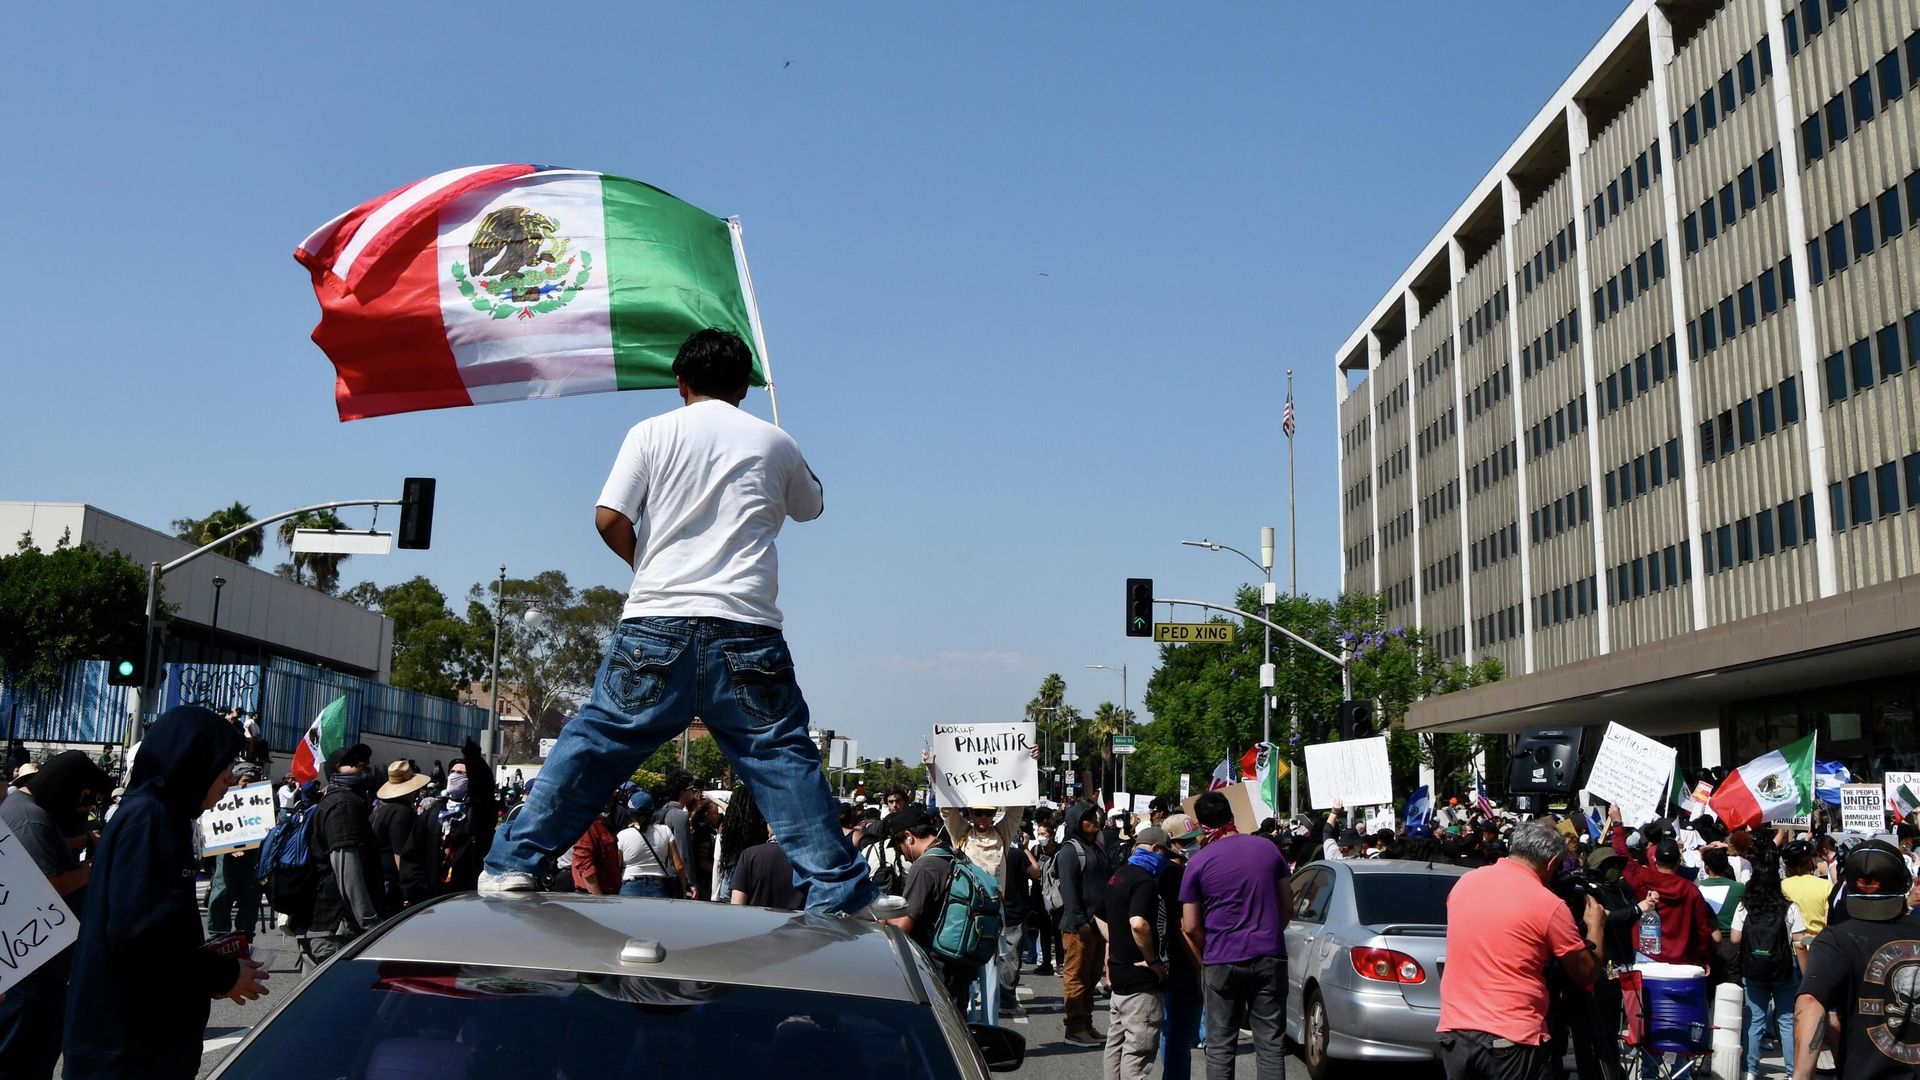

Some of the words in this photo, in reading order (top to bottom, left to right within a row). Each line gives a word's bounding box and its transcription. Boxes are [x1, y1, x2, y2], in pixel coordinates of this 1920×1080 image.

[1161, 627, 1189, 639] PED
[1195, 627, 1227, 639] XING
[977, 757, 999, 765] AND
[945, 770, 992, 786] PETER
[976, 779, 1022, 794] THIEL
[210, 794, 244, 812] uck
[1844, 796, 1880, 805] UNITED
[1862, 1001, 1880, 1012] 20
